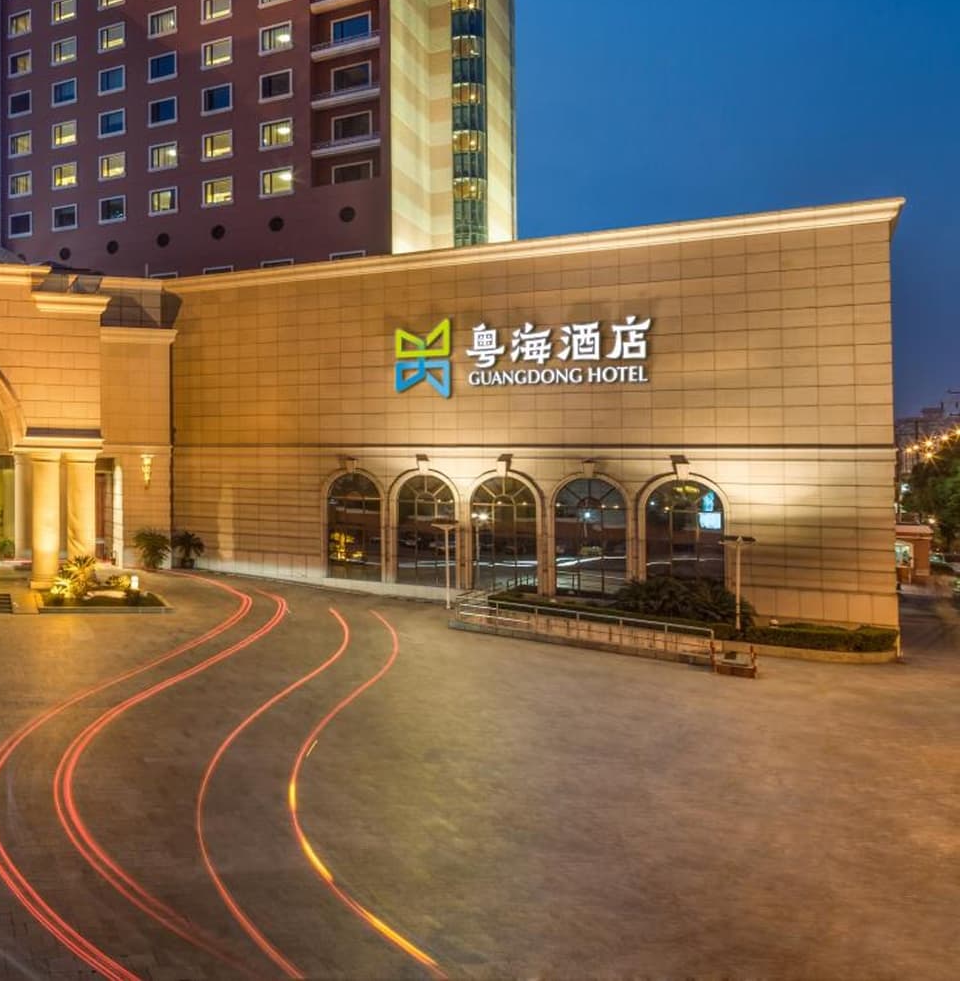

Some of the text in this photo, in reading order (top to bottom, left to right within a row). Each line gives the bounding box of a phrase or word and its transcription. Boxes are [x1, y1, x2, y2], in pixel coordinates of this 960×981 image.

[466, 315, 651, 367] 粤海酒店
[468, 365, 648, 386] GUANGDONG HOTEL
